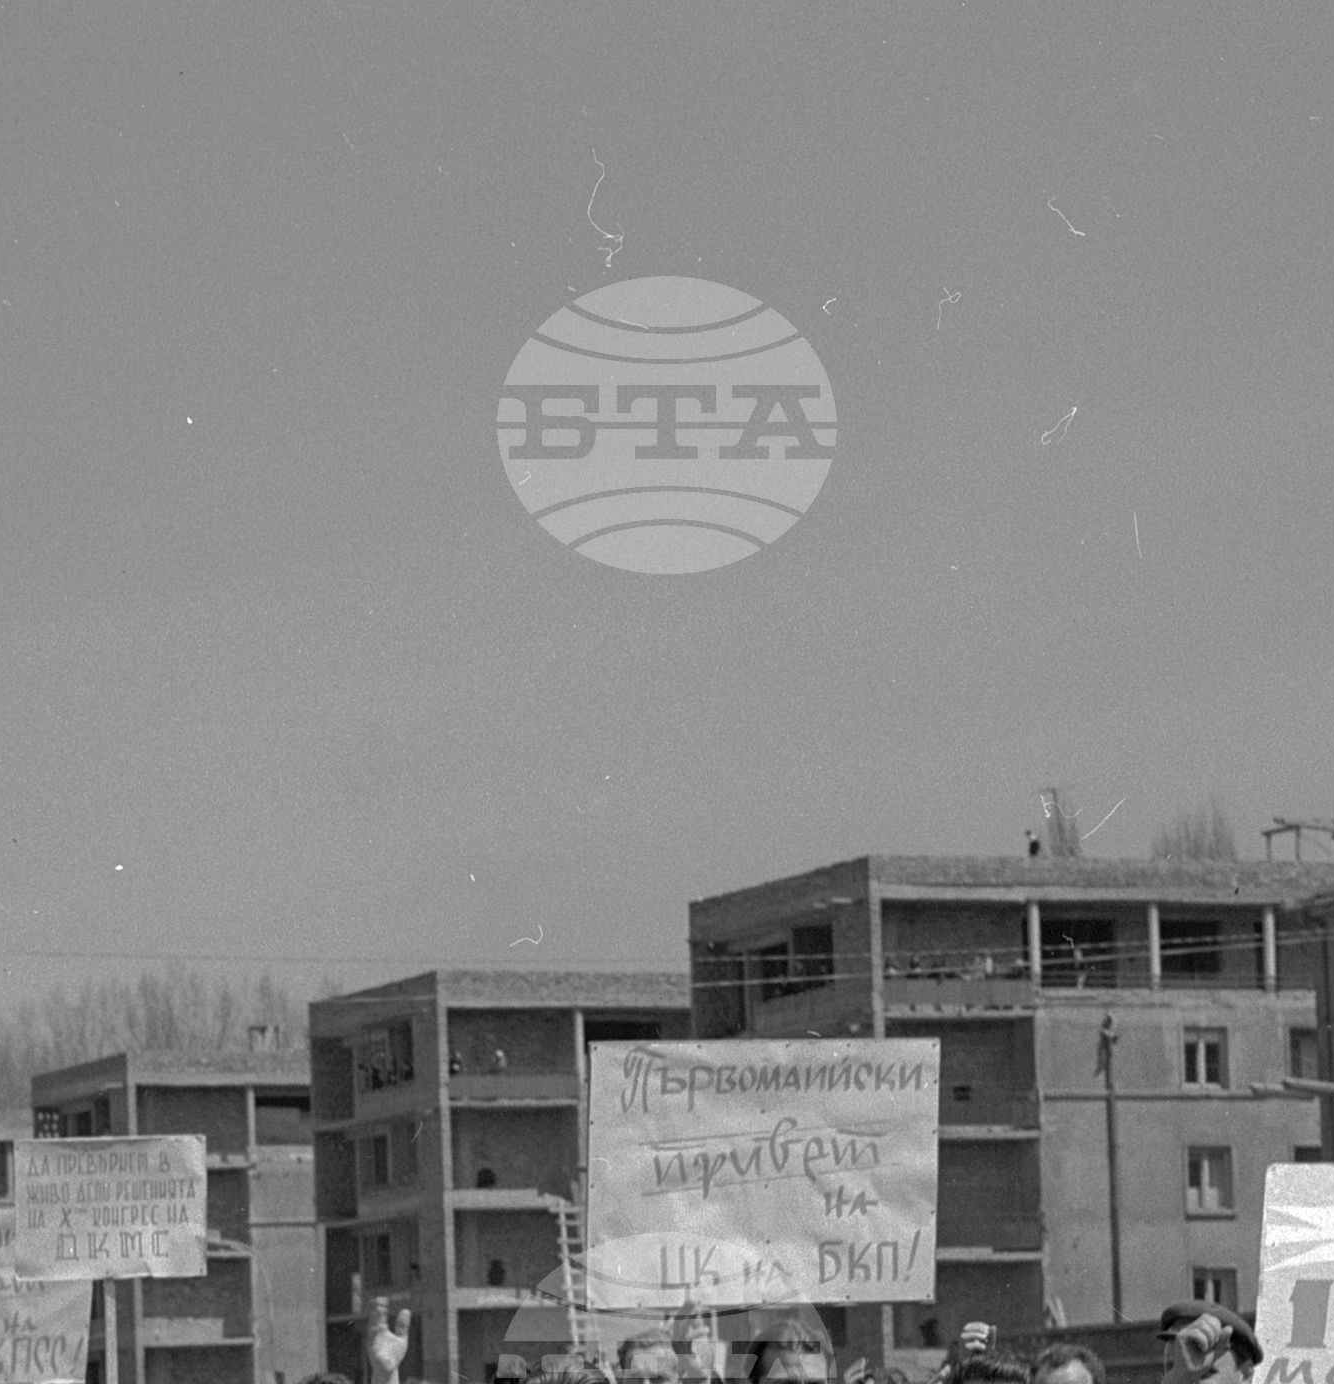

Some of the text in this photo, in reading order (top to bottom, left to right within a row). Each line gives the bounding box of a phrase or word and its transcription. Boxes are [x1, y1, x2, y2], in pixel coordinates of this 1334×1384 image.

[27, 1155, 50, 1177] ДА
[159, 1152, 172, 1173] В
[650, 1117, 885, 1199] привет
[26, 1182, 71, 1203] ЖИВО
[27, 1208, 46, 1229] НА
[93, 1204, 160, 1228] КОНГРЕС
[167, 1204, 189, 1225] НА
[660, 1243, 720, 1288] ЦК
[818, 1229, 921, 1285] БКП!
[1285, 1279, 1334, 1348] 1
